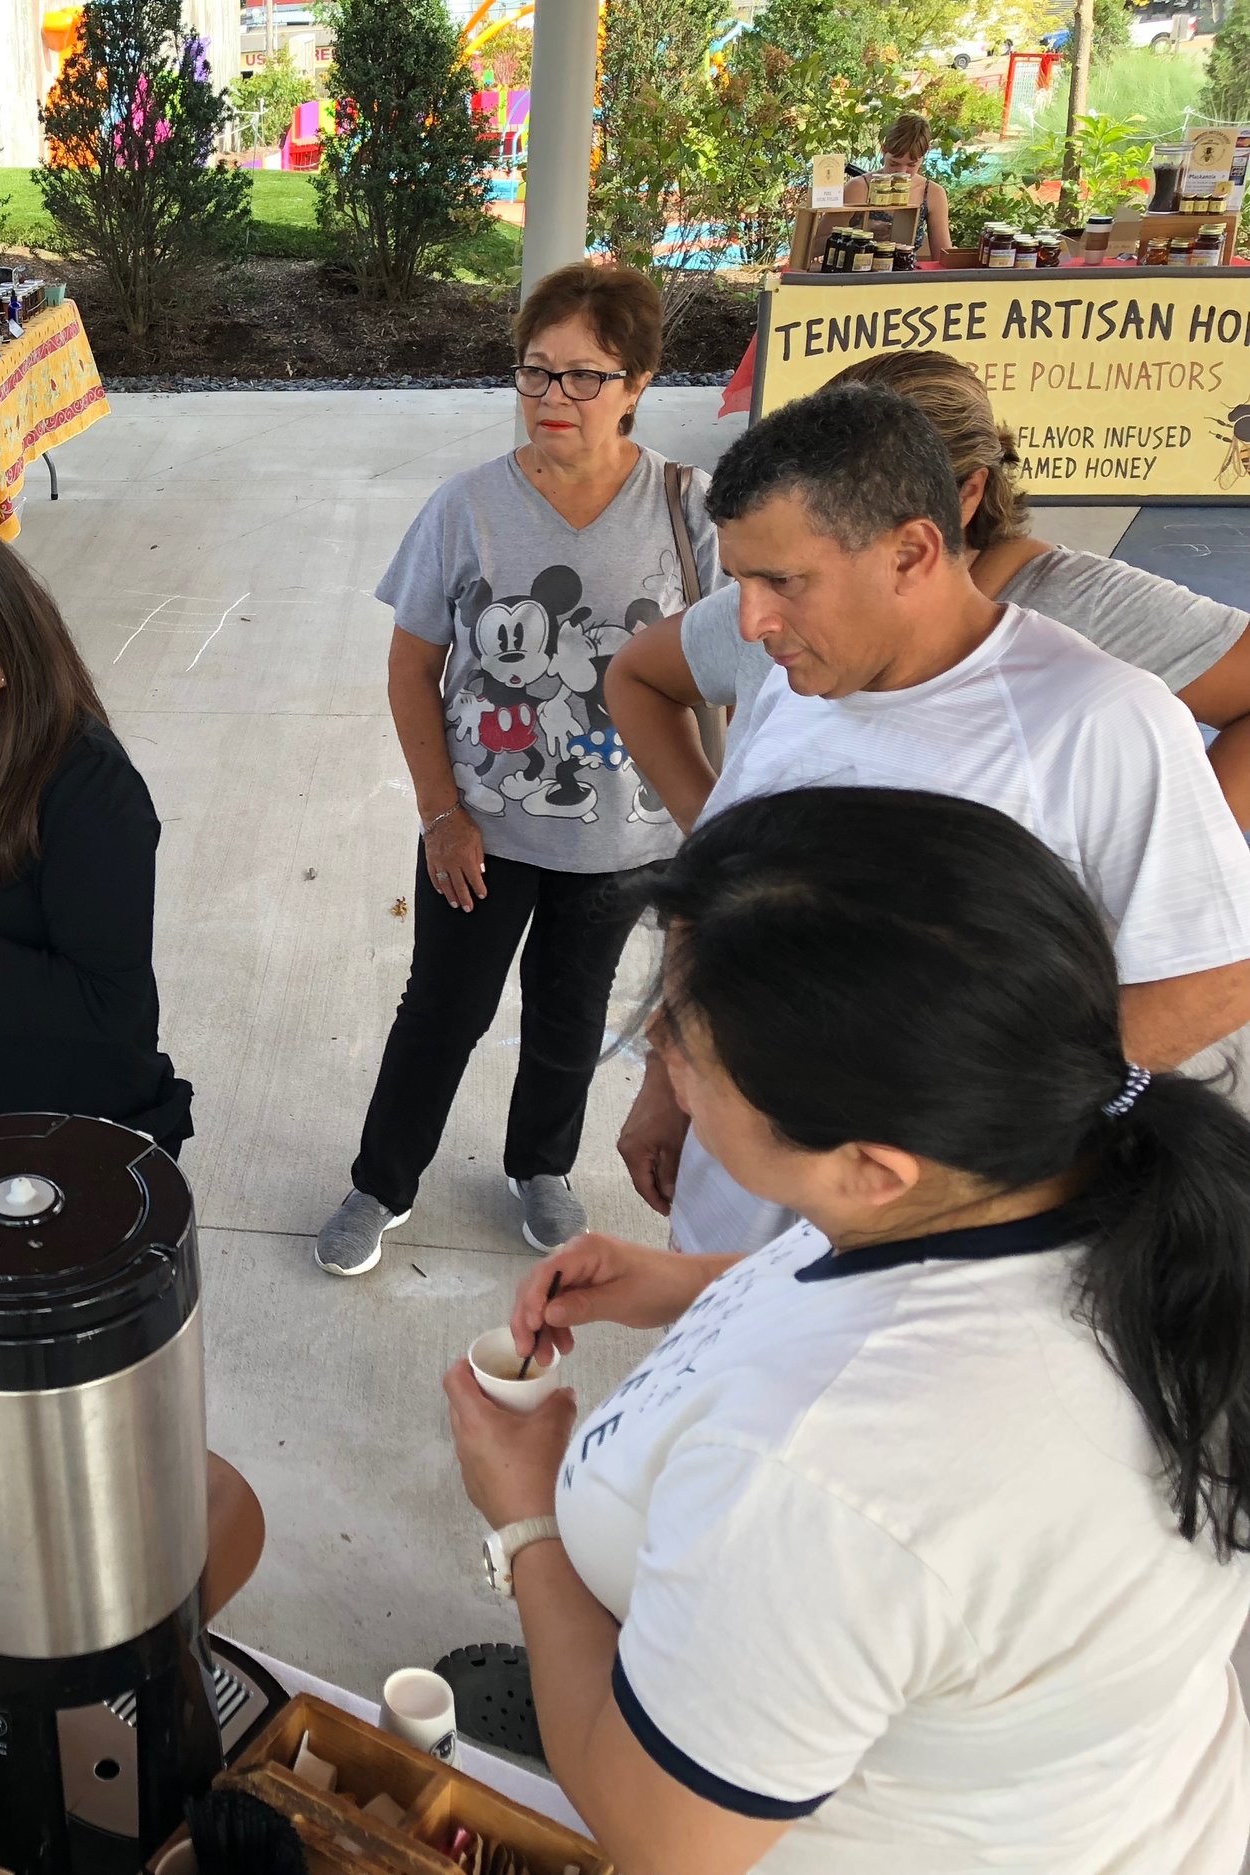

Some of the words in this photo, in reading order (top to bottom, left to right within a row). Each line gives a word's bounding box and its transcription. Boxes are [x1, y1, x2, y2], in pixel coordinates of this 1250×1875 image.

[775, 301, 987, 361] TENNESSEE
[1002, 298, 1175, 342] ARTISAN
[1189, 304, 1250, 347] HO
[1030, 360, 1224, 393] POLLINATORS
[1017, 425, 1094, 449] FLAVOR
[1104, 425, 1192, 450] INFUSED
[1020, 455, 1077, 479] AMED
[1085, 456, 1157, 480] HONEY
